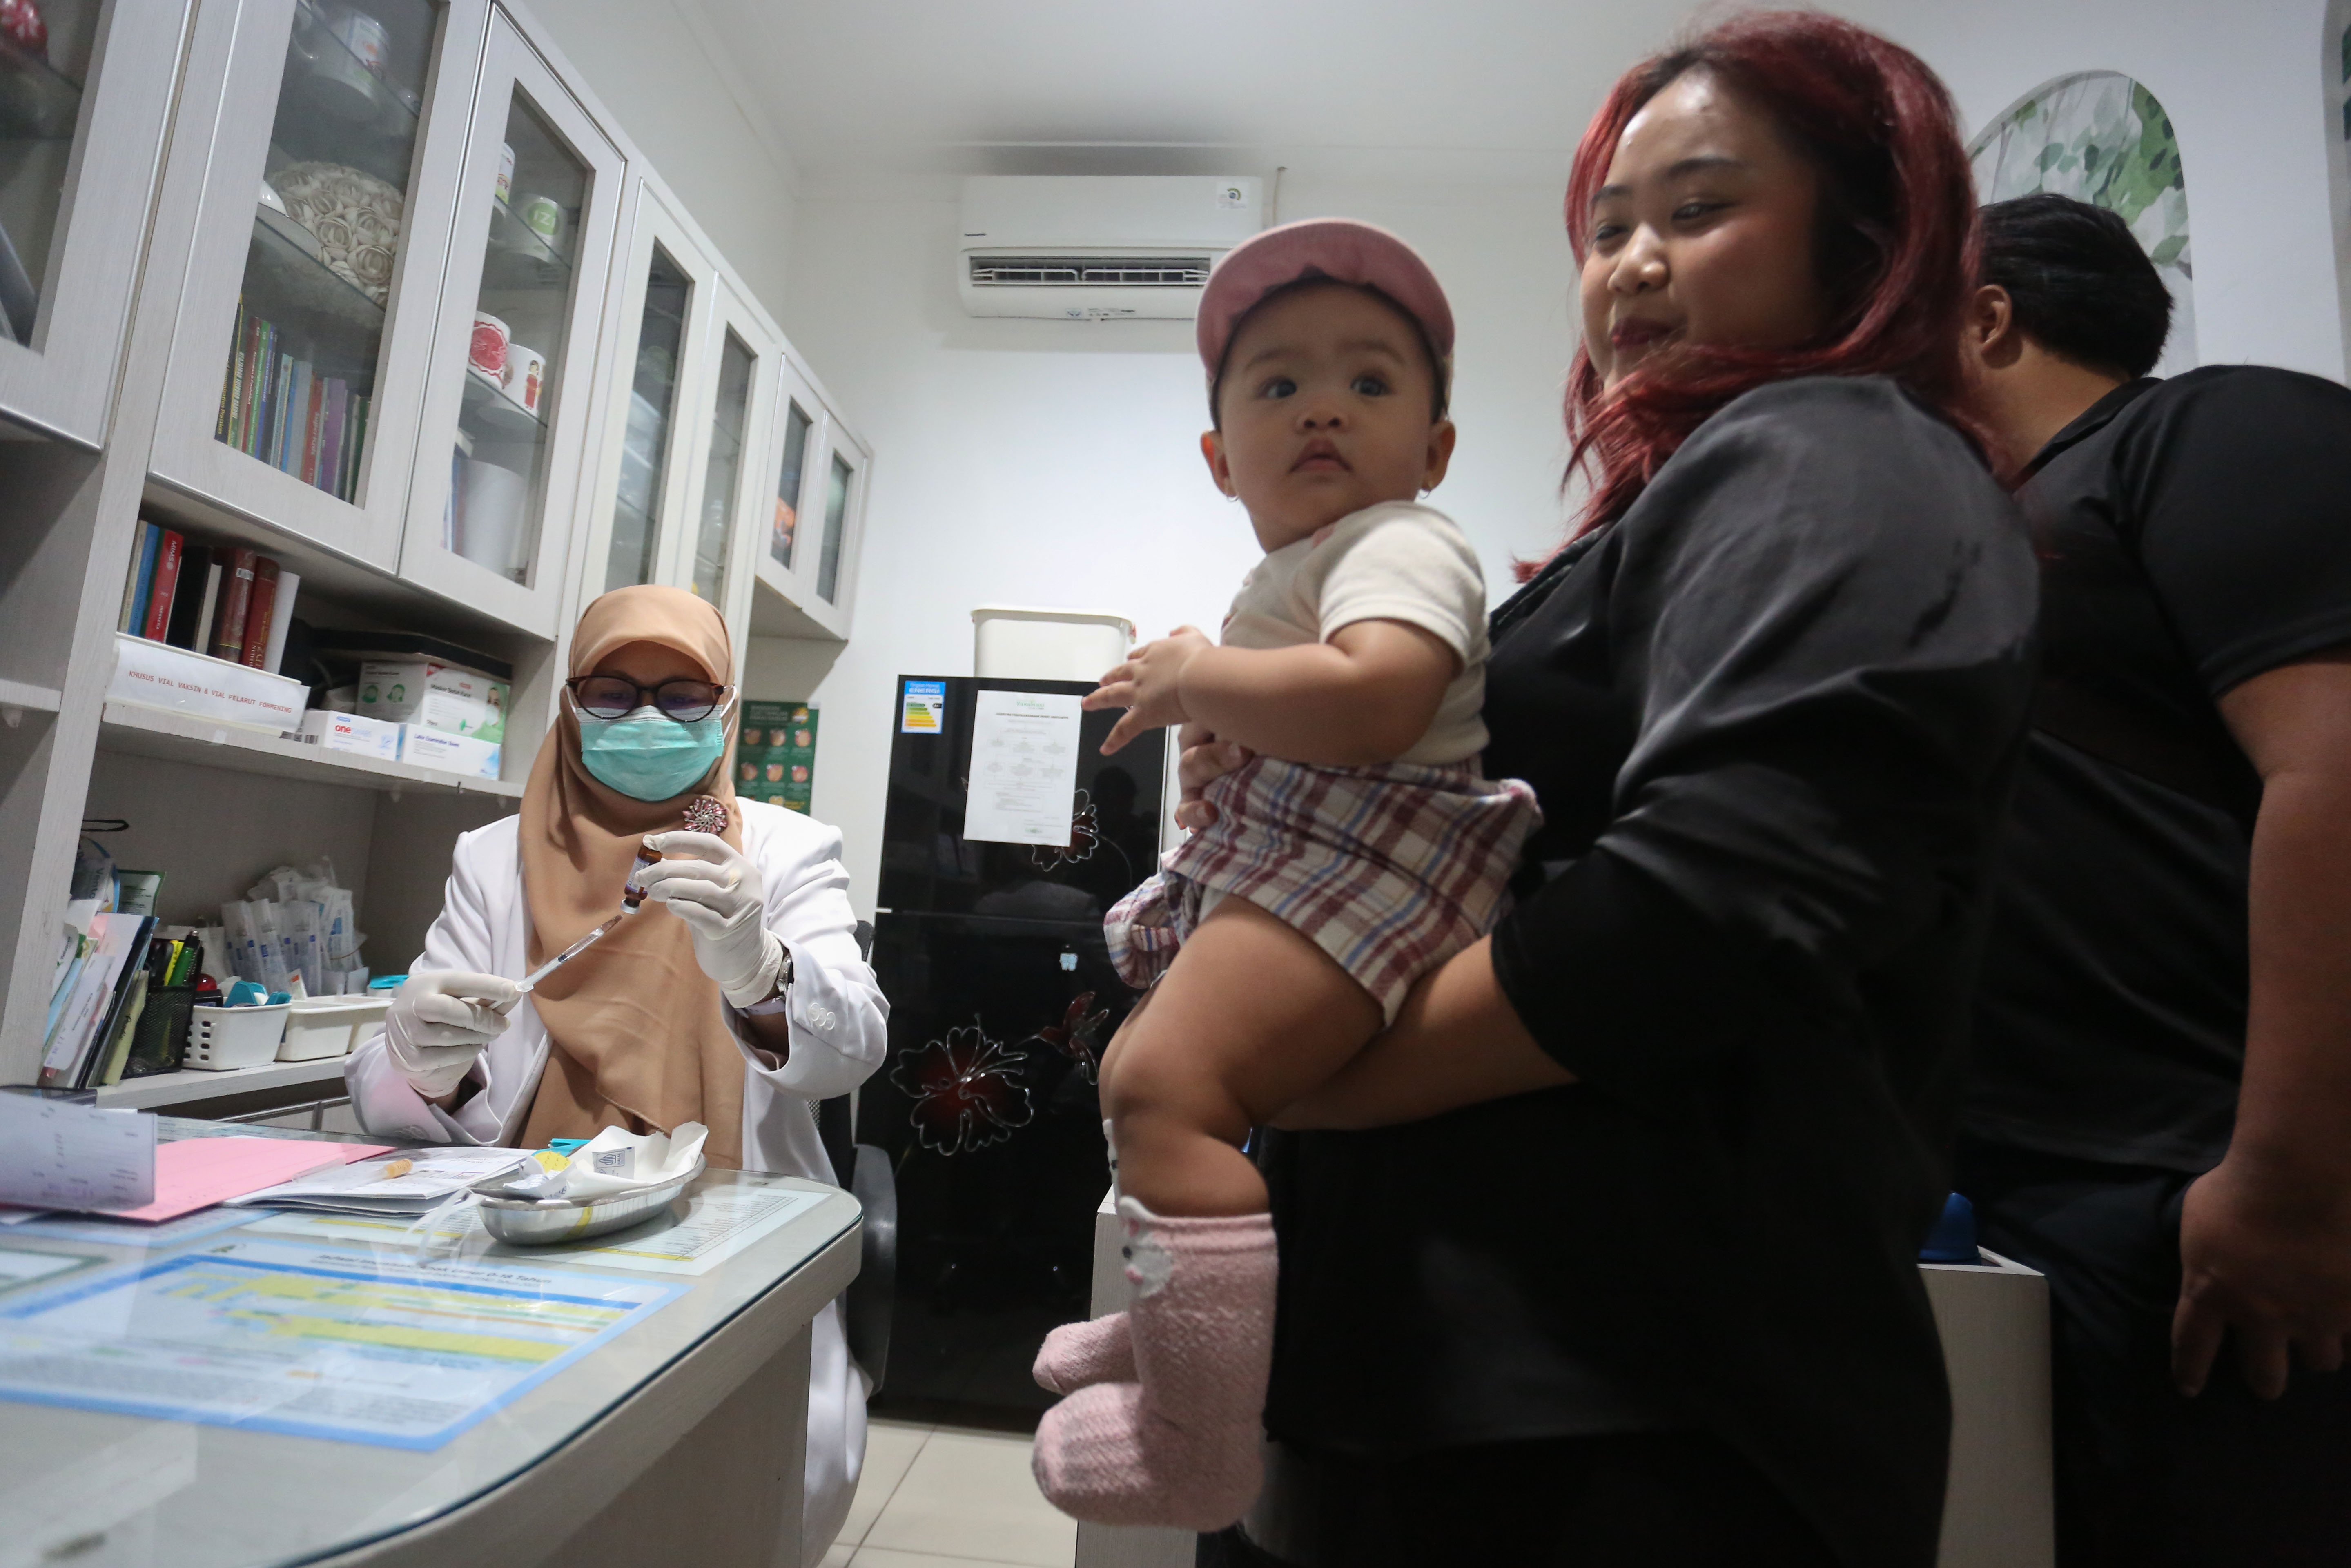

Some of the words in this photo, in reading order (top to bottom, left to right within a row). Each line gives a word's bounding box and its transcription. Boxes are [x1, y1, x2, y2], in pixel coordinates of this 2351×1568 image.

[168, 540, 177, 562] MIMS
[129, 670, 154, 682] KHUSUS
[158, 677, 174, 686] VIAL
[178, 682, 201, 693] VAKSIN
[212, 690, 225, 698] VIAL
[228, 694, 256, 705] PELARUT
[515, 1274, 552, 1283] Tahun
